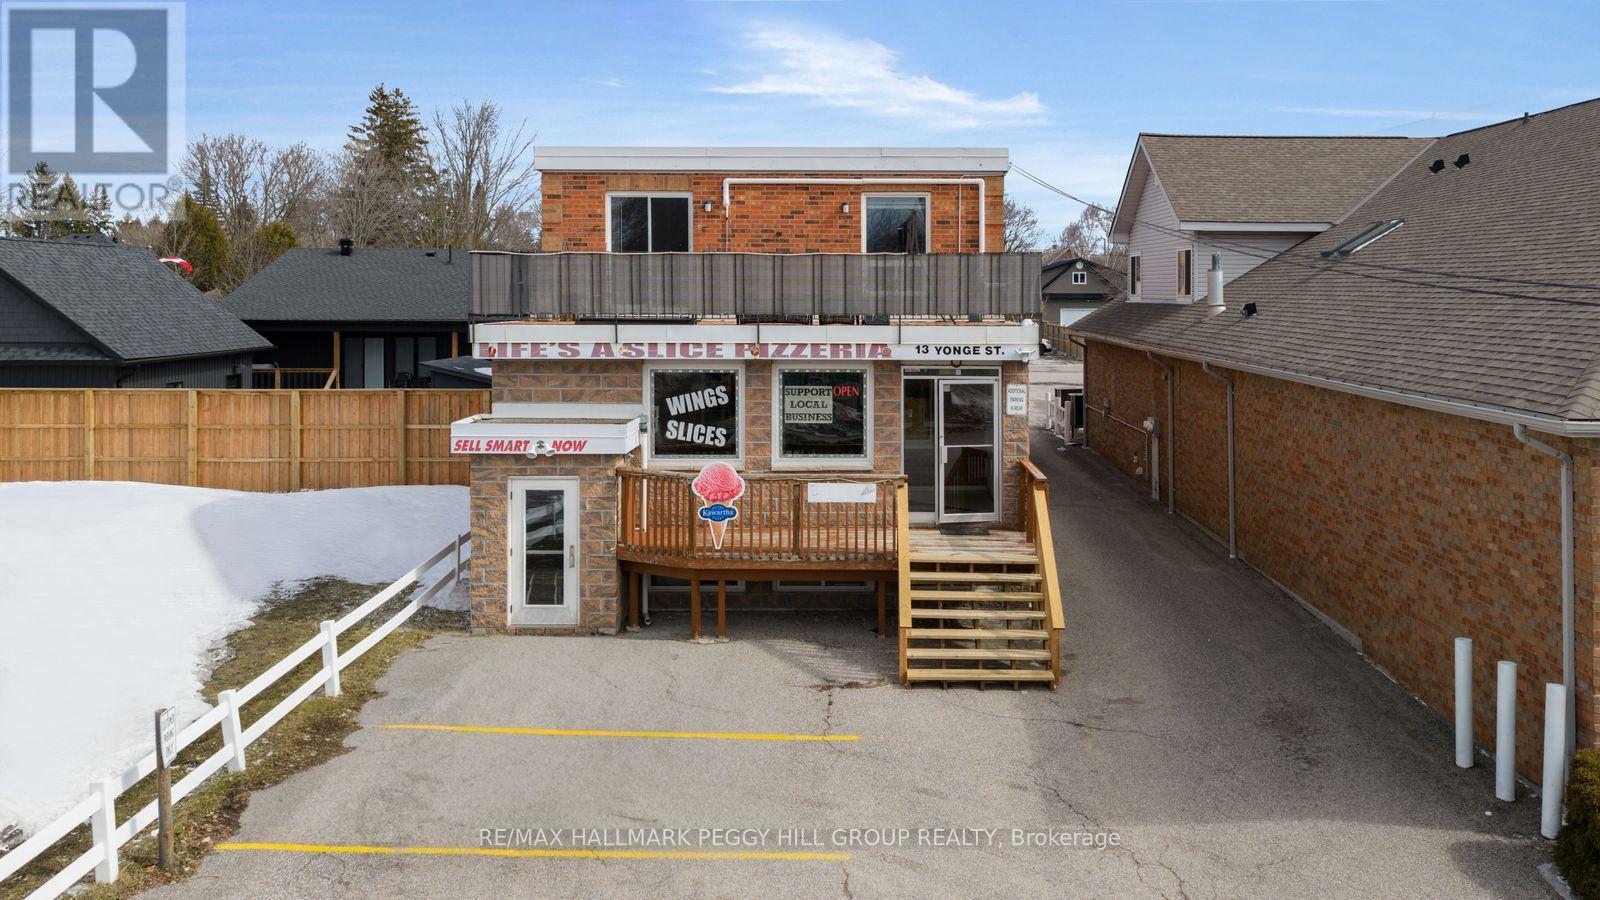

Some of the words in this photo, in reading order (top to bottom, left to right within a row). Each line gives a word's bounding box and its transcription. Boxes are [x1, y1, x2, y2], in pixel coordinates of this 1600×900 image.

[590, 342, 615, 358] A
[623, 342, 724, 358] SLICE
[735, 342, 892, 358] PIZZERIA
[915, 345, 929, 355] 13
[934, 345, 981, 356] YONGE
[985, 346, 1005, 356] ST.
[785, 388, 832, 397] SUPPORT
[833, 385, 859, 397] OPEN
[665, 385, 729, 416] WINGS
[790, 400, 828, 409] LOCAL
[785, 413, 832, 421] BUSINESS
[665, 419, 728, 447] SLICES
[454, 439, 482, 452] SELL
[485, 439, 531, 452] SMART
[551, 440, 587, 452] NOW
[702, 509, 734, 517] Kawartha
